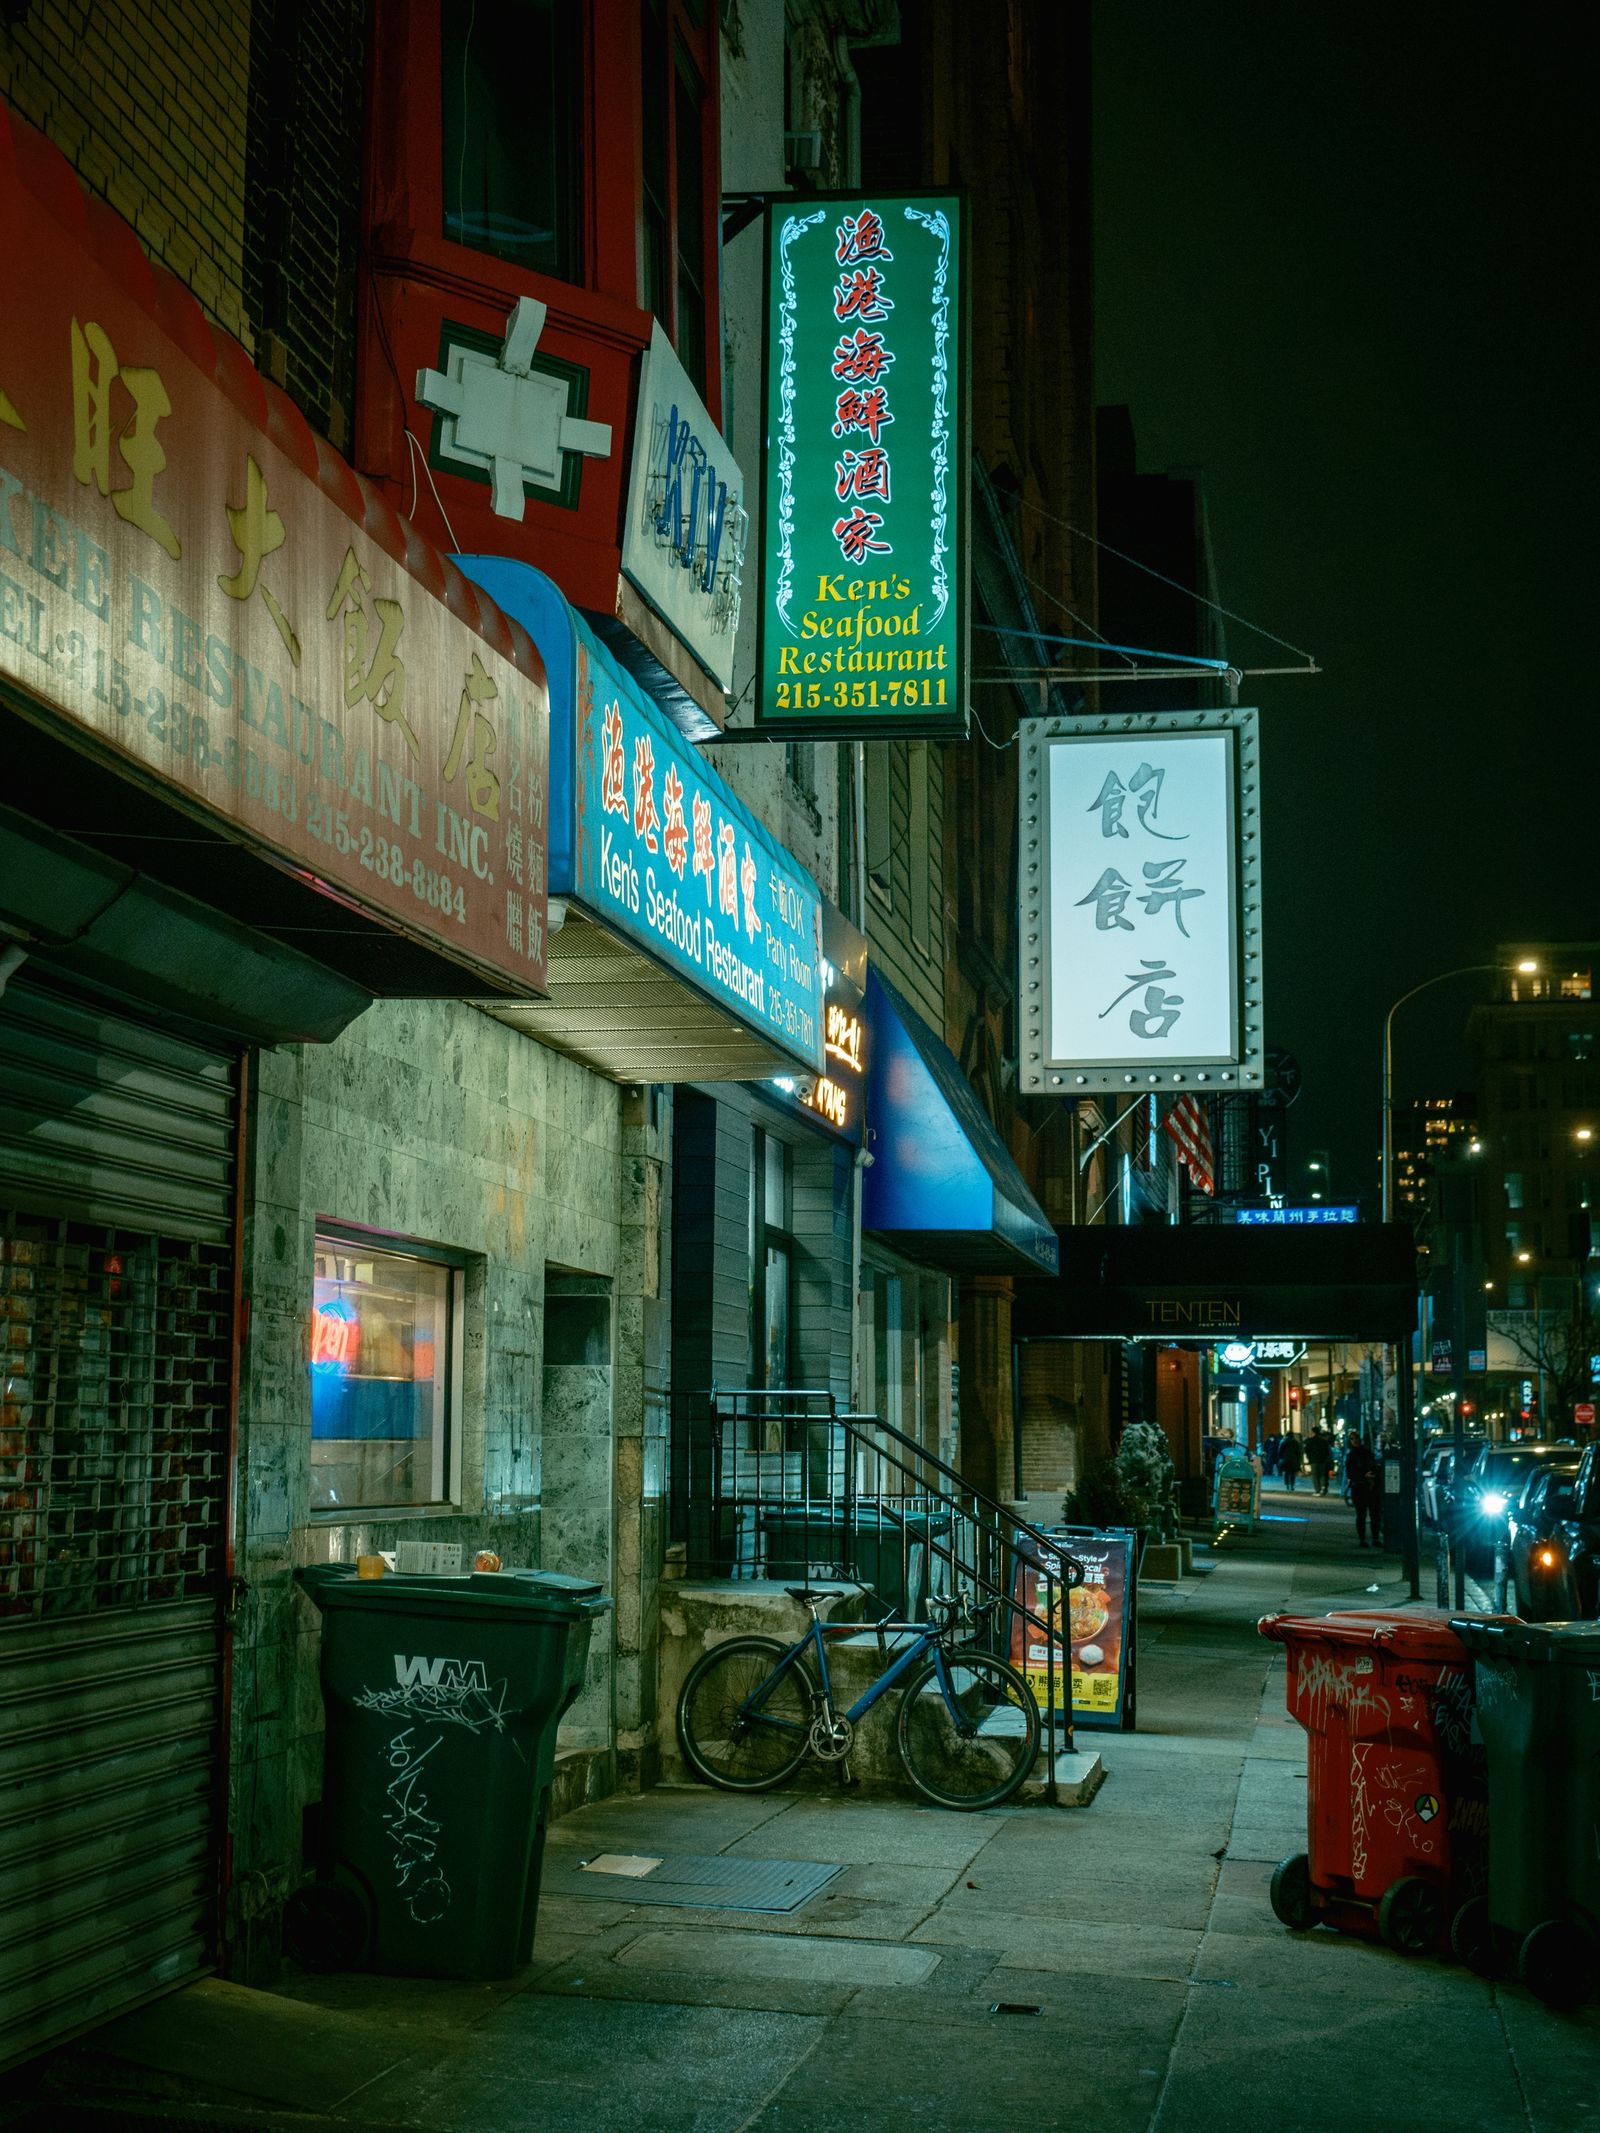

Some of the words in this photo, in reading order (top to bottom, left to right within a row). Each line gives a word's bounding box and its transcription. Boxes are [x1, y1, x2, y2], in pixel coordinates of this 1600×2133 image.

[831, 208, 896, 567] 漁港海鮮酒家
[0, 313, 500, 822] 旺大飯店
[799, 603, 924, 650] Seafood
[815, 572, 911, 603] Ken's
[776, 679, 949, 710] 215-351-7811
[778, 644, 949, 675] Restaurant
[128, 574, 427, 840] RESTAURANT
[436, 799, 493, 886] INC.
[307, 790, 467, 925] 215-238-8884
[504, 695, 524, 956] 名燒臘
[527, 700, 544, 967] 粉麵飯
[601, 700, 762, 944] 漁港海鮮酒家
[601, 824, 640, 915] Ken's
[646, 874, 701, 964] Seafood
[706, 915, 765, 1014] Restaurant
[765, 922, 788, 982] Party
[790, 943, 812, 992] Room
[1145, 1300, 1241, 1323] TENTEN
[393, 1654, 490, 1692] WM
